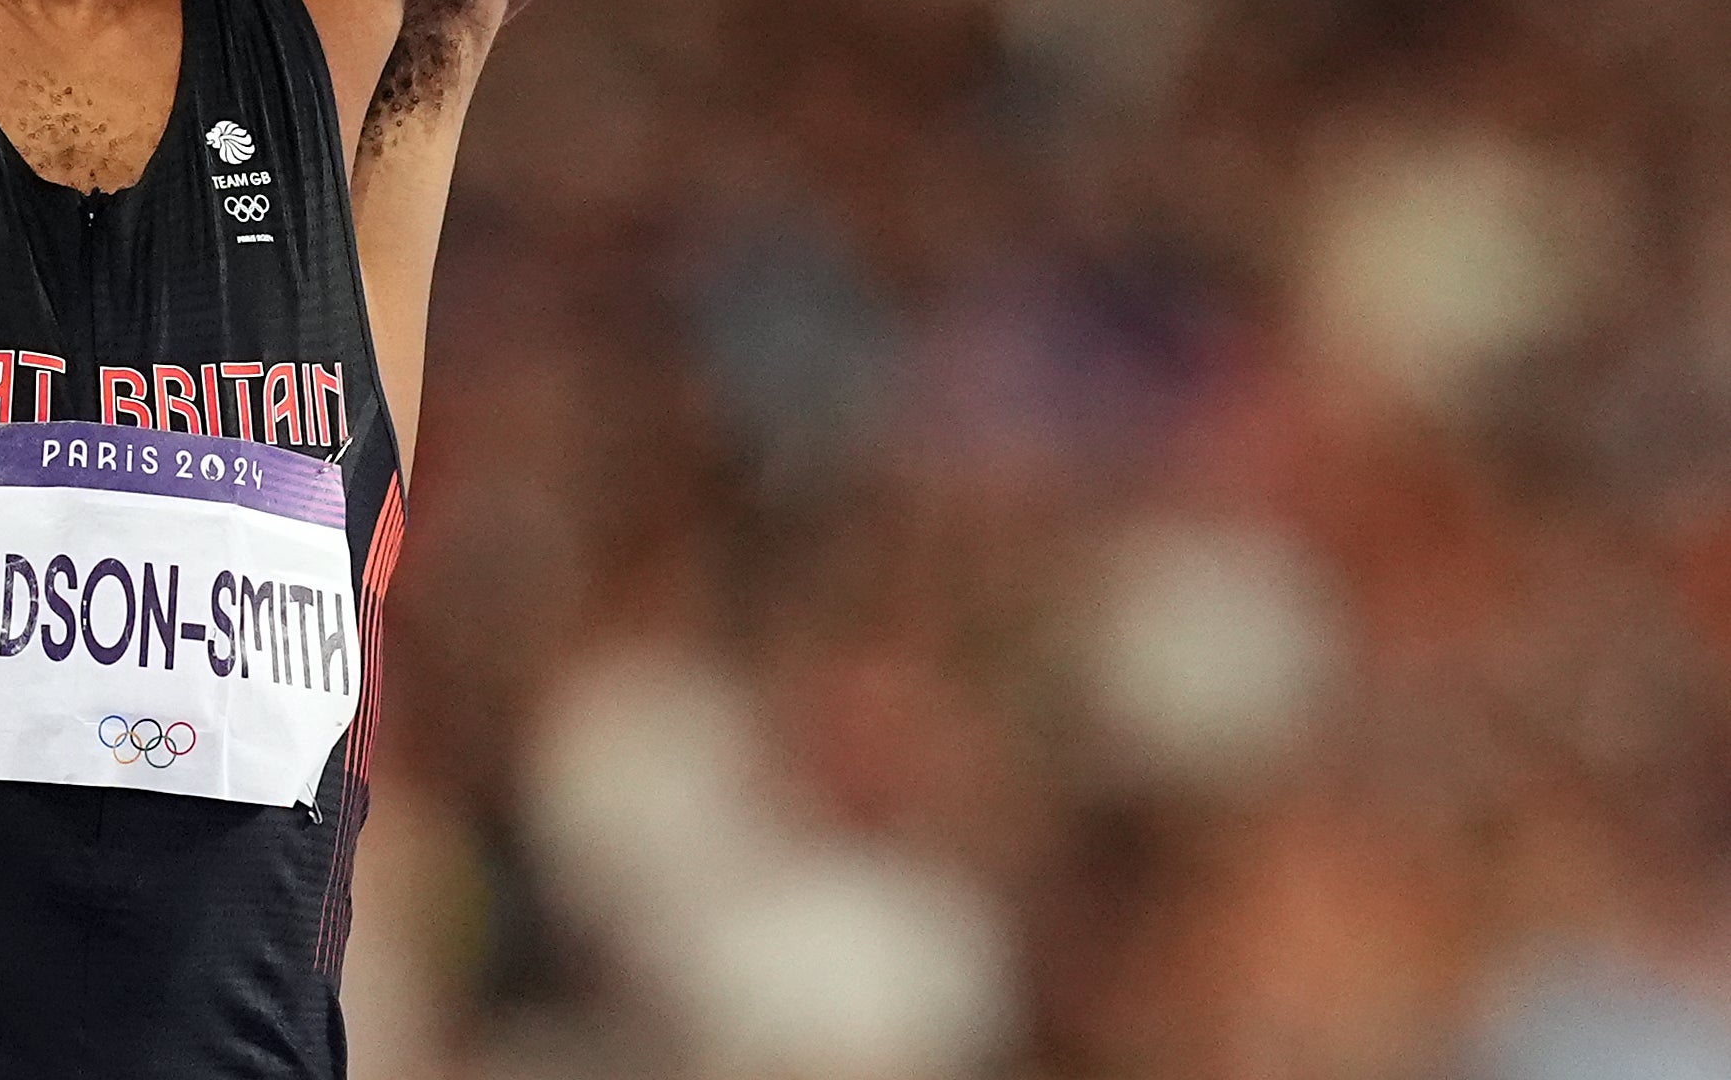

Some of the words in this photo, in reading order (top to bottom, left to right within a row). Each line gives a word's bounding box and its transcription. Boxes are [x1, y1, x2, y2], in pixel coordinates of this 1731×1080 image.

[211, 172, 249, 190] TEAM
[249, 171, 272, 186] GB
[99, 362, 349, 447] BRITAIN
[175, 450, 264, 491] 2024
